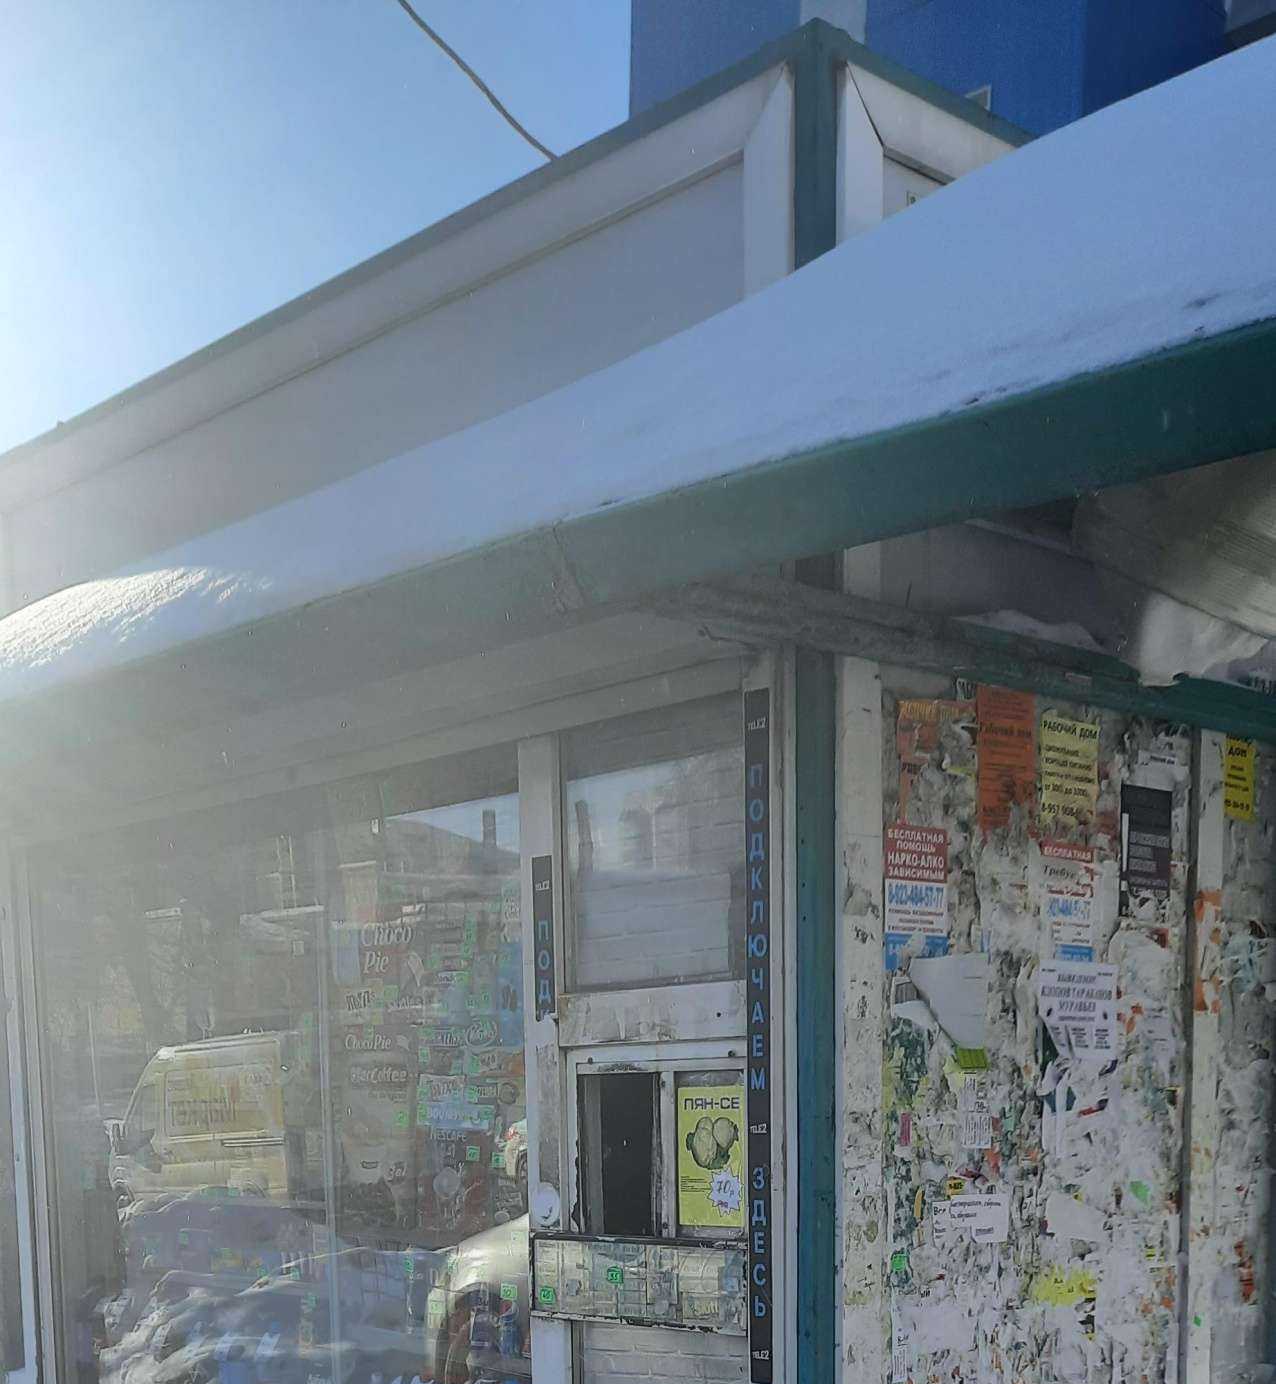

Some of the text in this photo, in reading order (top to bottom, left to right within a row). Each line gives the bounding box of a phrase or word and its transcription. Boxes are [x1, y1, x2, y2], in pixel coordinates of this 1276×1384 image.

[888, 828, 944, 844] БЕСПЛАТНАЯ
[896, 841, 936, 853] ПОМОЩЬ
[887, 852, 945, 868] НАРКО-АЛКО
[888, 866, 945, 881] ЗАВИСИМЫМ
[748, 764, 769, 1091] ПОДКЛЮЧАЕМ
[363, 951, 390, 974] Pie
[684, 1096, 740, 1111] ПЯН-СЕ
[751, 1167, 768, 1318] ЗДЕСЬ
[752, 1349, 769, 1361] TELE2
